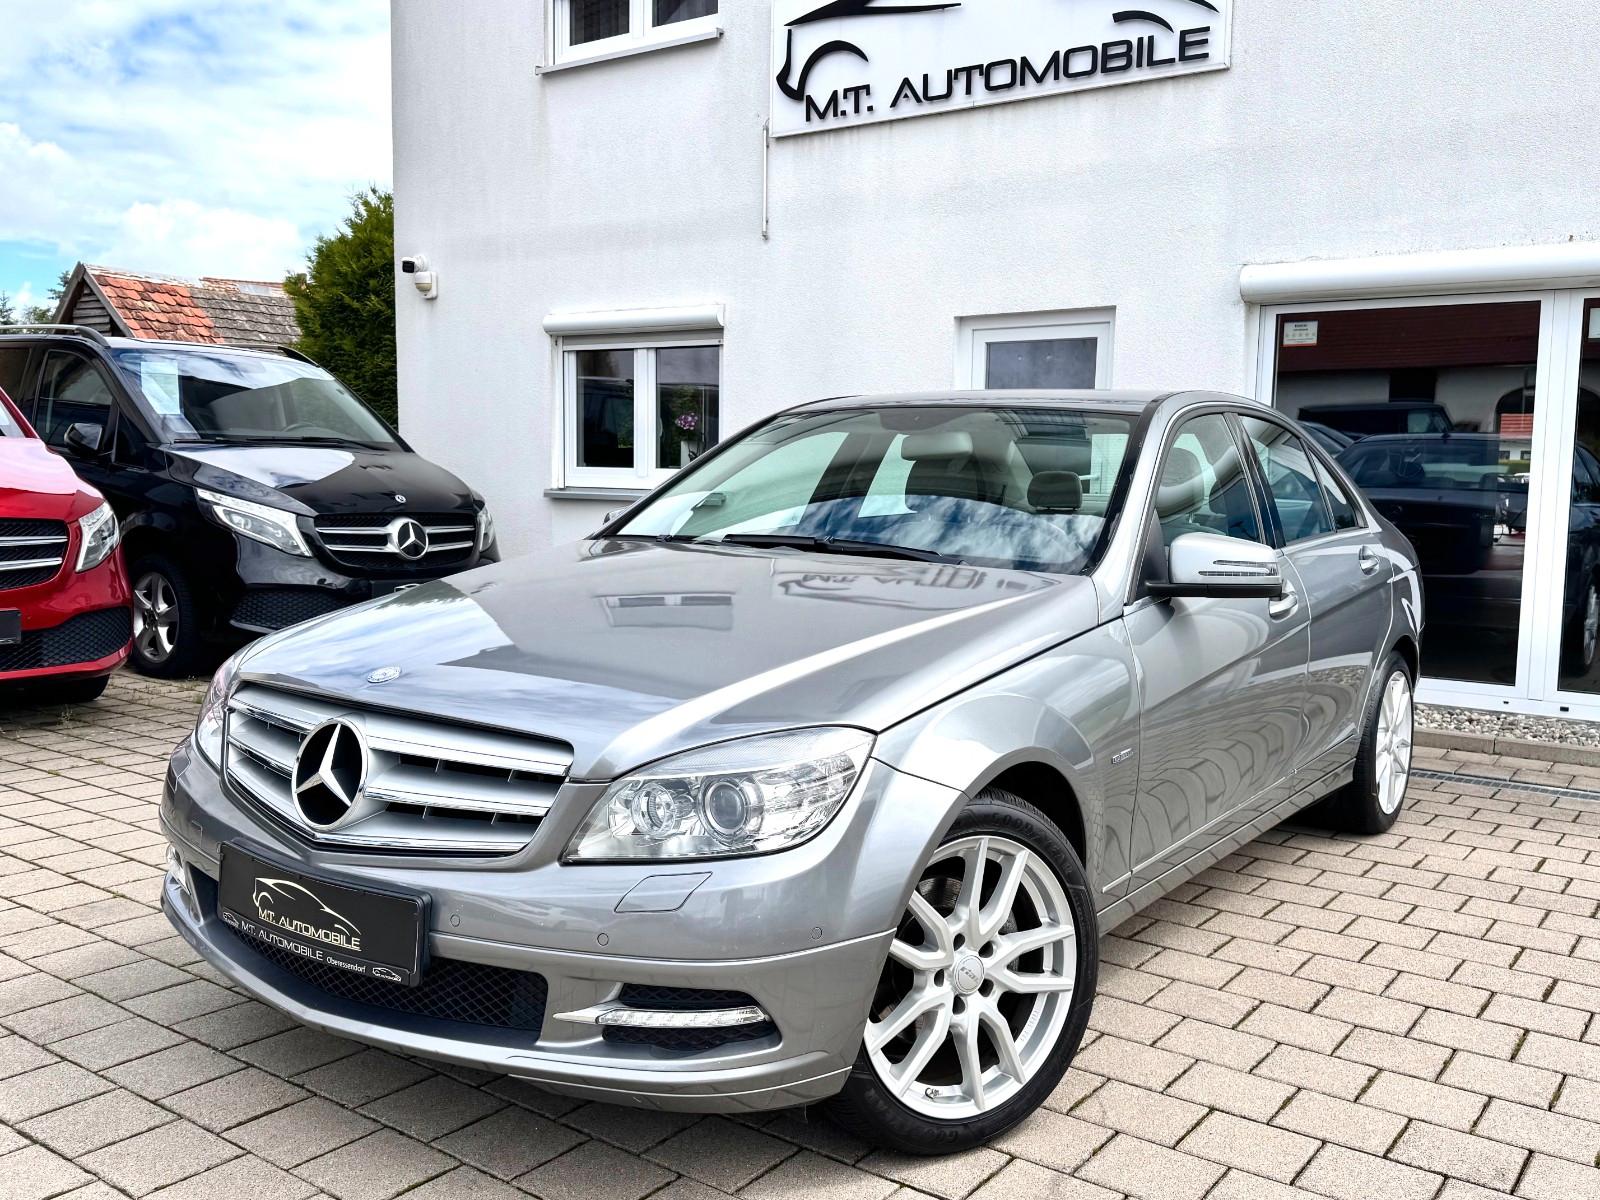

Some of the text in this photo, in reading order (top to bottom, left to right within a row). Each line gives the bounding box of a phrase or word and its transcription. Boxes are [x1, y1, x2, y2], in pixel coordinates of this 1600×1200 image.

[805, 26, 1211, 122] M.T. AUTOMOBILE
[241, 920, 256, 936] M.T.
[258, 929, 324, 961] AUTOMOBILE
[326, 956, 367, 974] Oberessendorf
[258, 907, 361, 950] M.T. AUTOMOBILE
